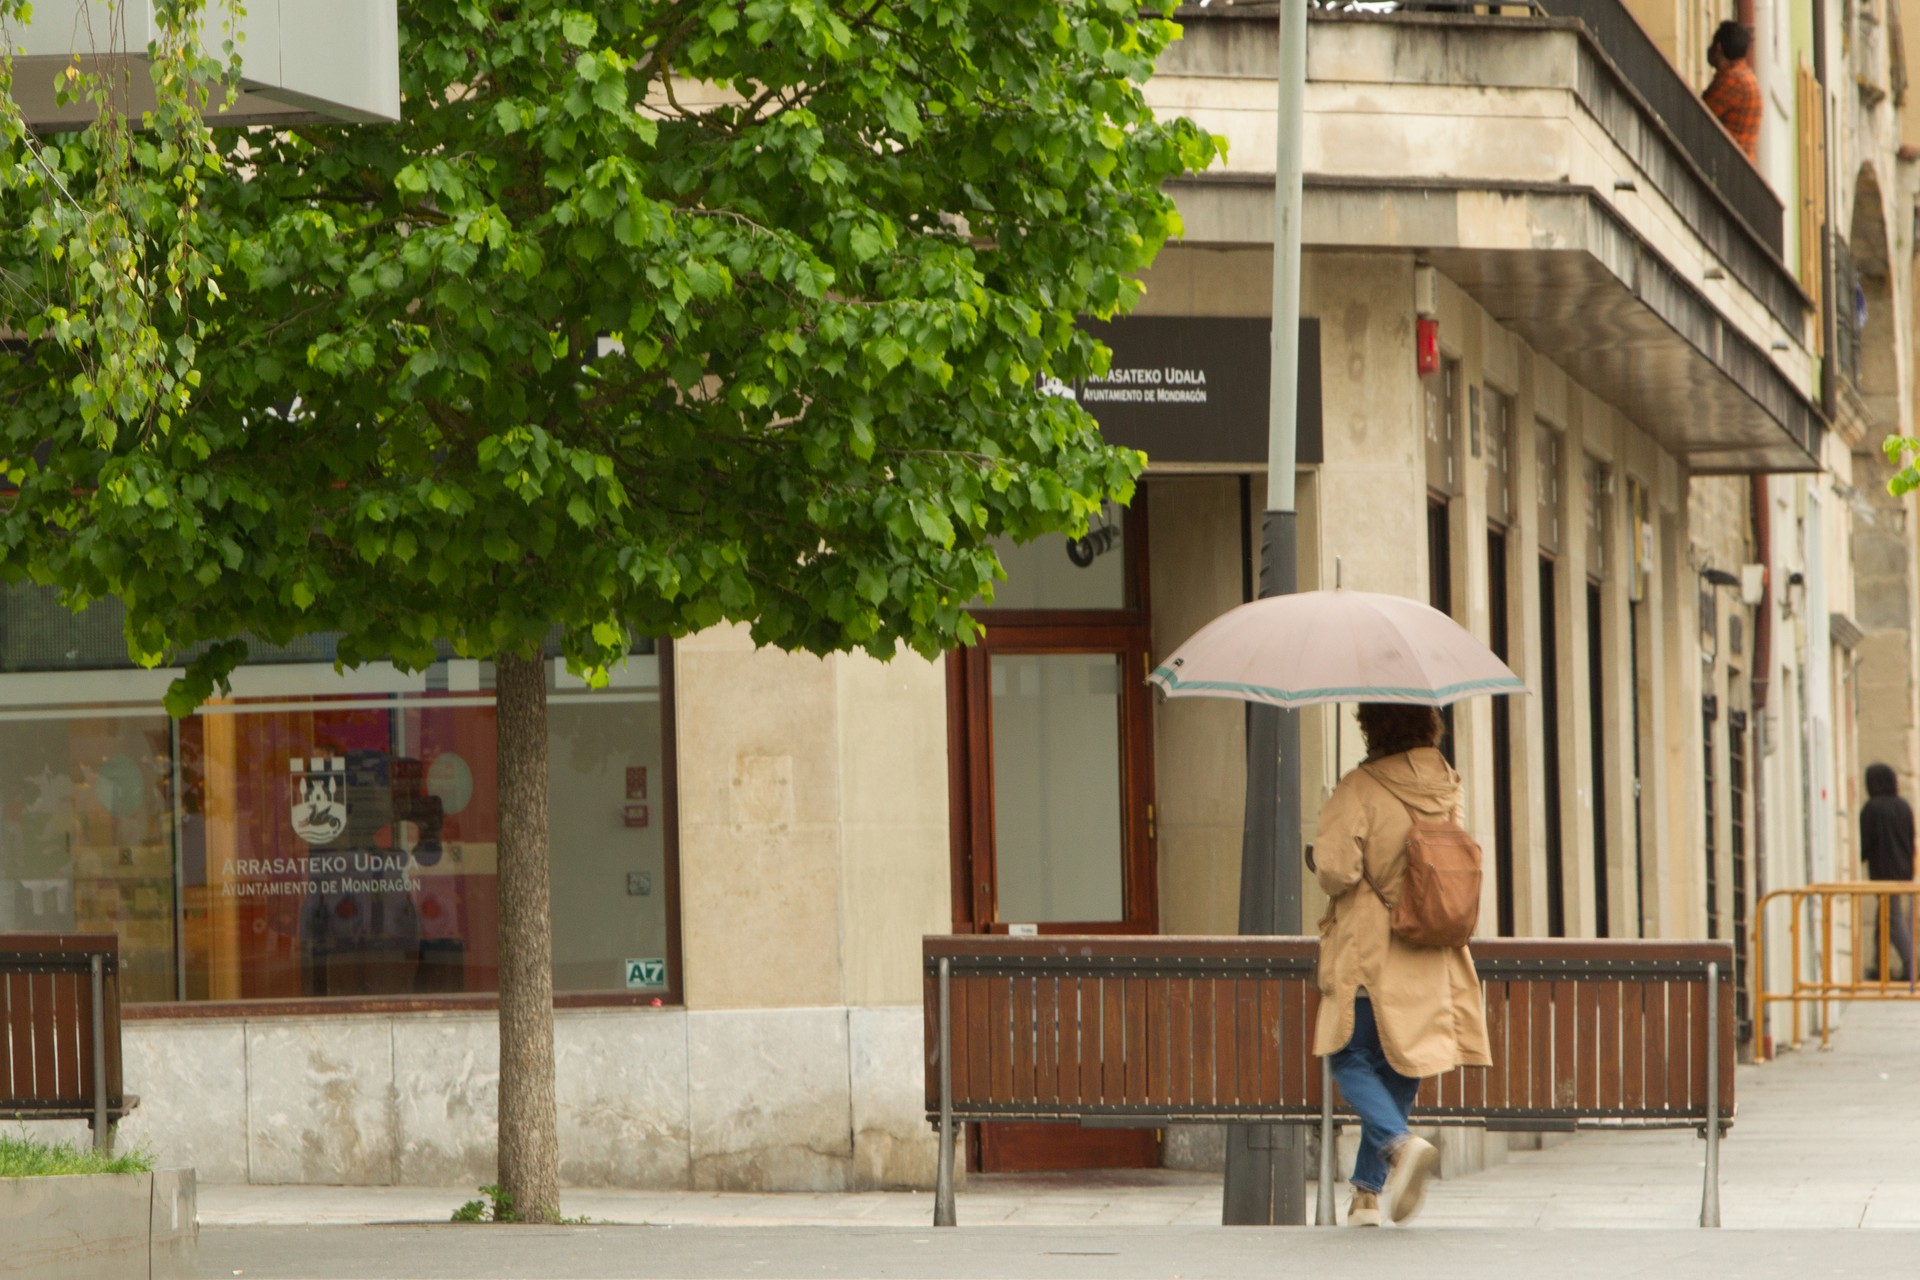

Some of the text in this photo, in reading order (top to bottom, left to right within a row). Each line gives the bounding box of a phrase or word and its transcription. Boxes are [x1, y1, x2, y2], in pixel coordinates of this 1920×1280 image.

[1144, 389, 1155, 402] DE
[321, 879, 338, 894] DE
[628, 963, 664, 983] A7
